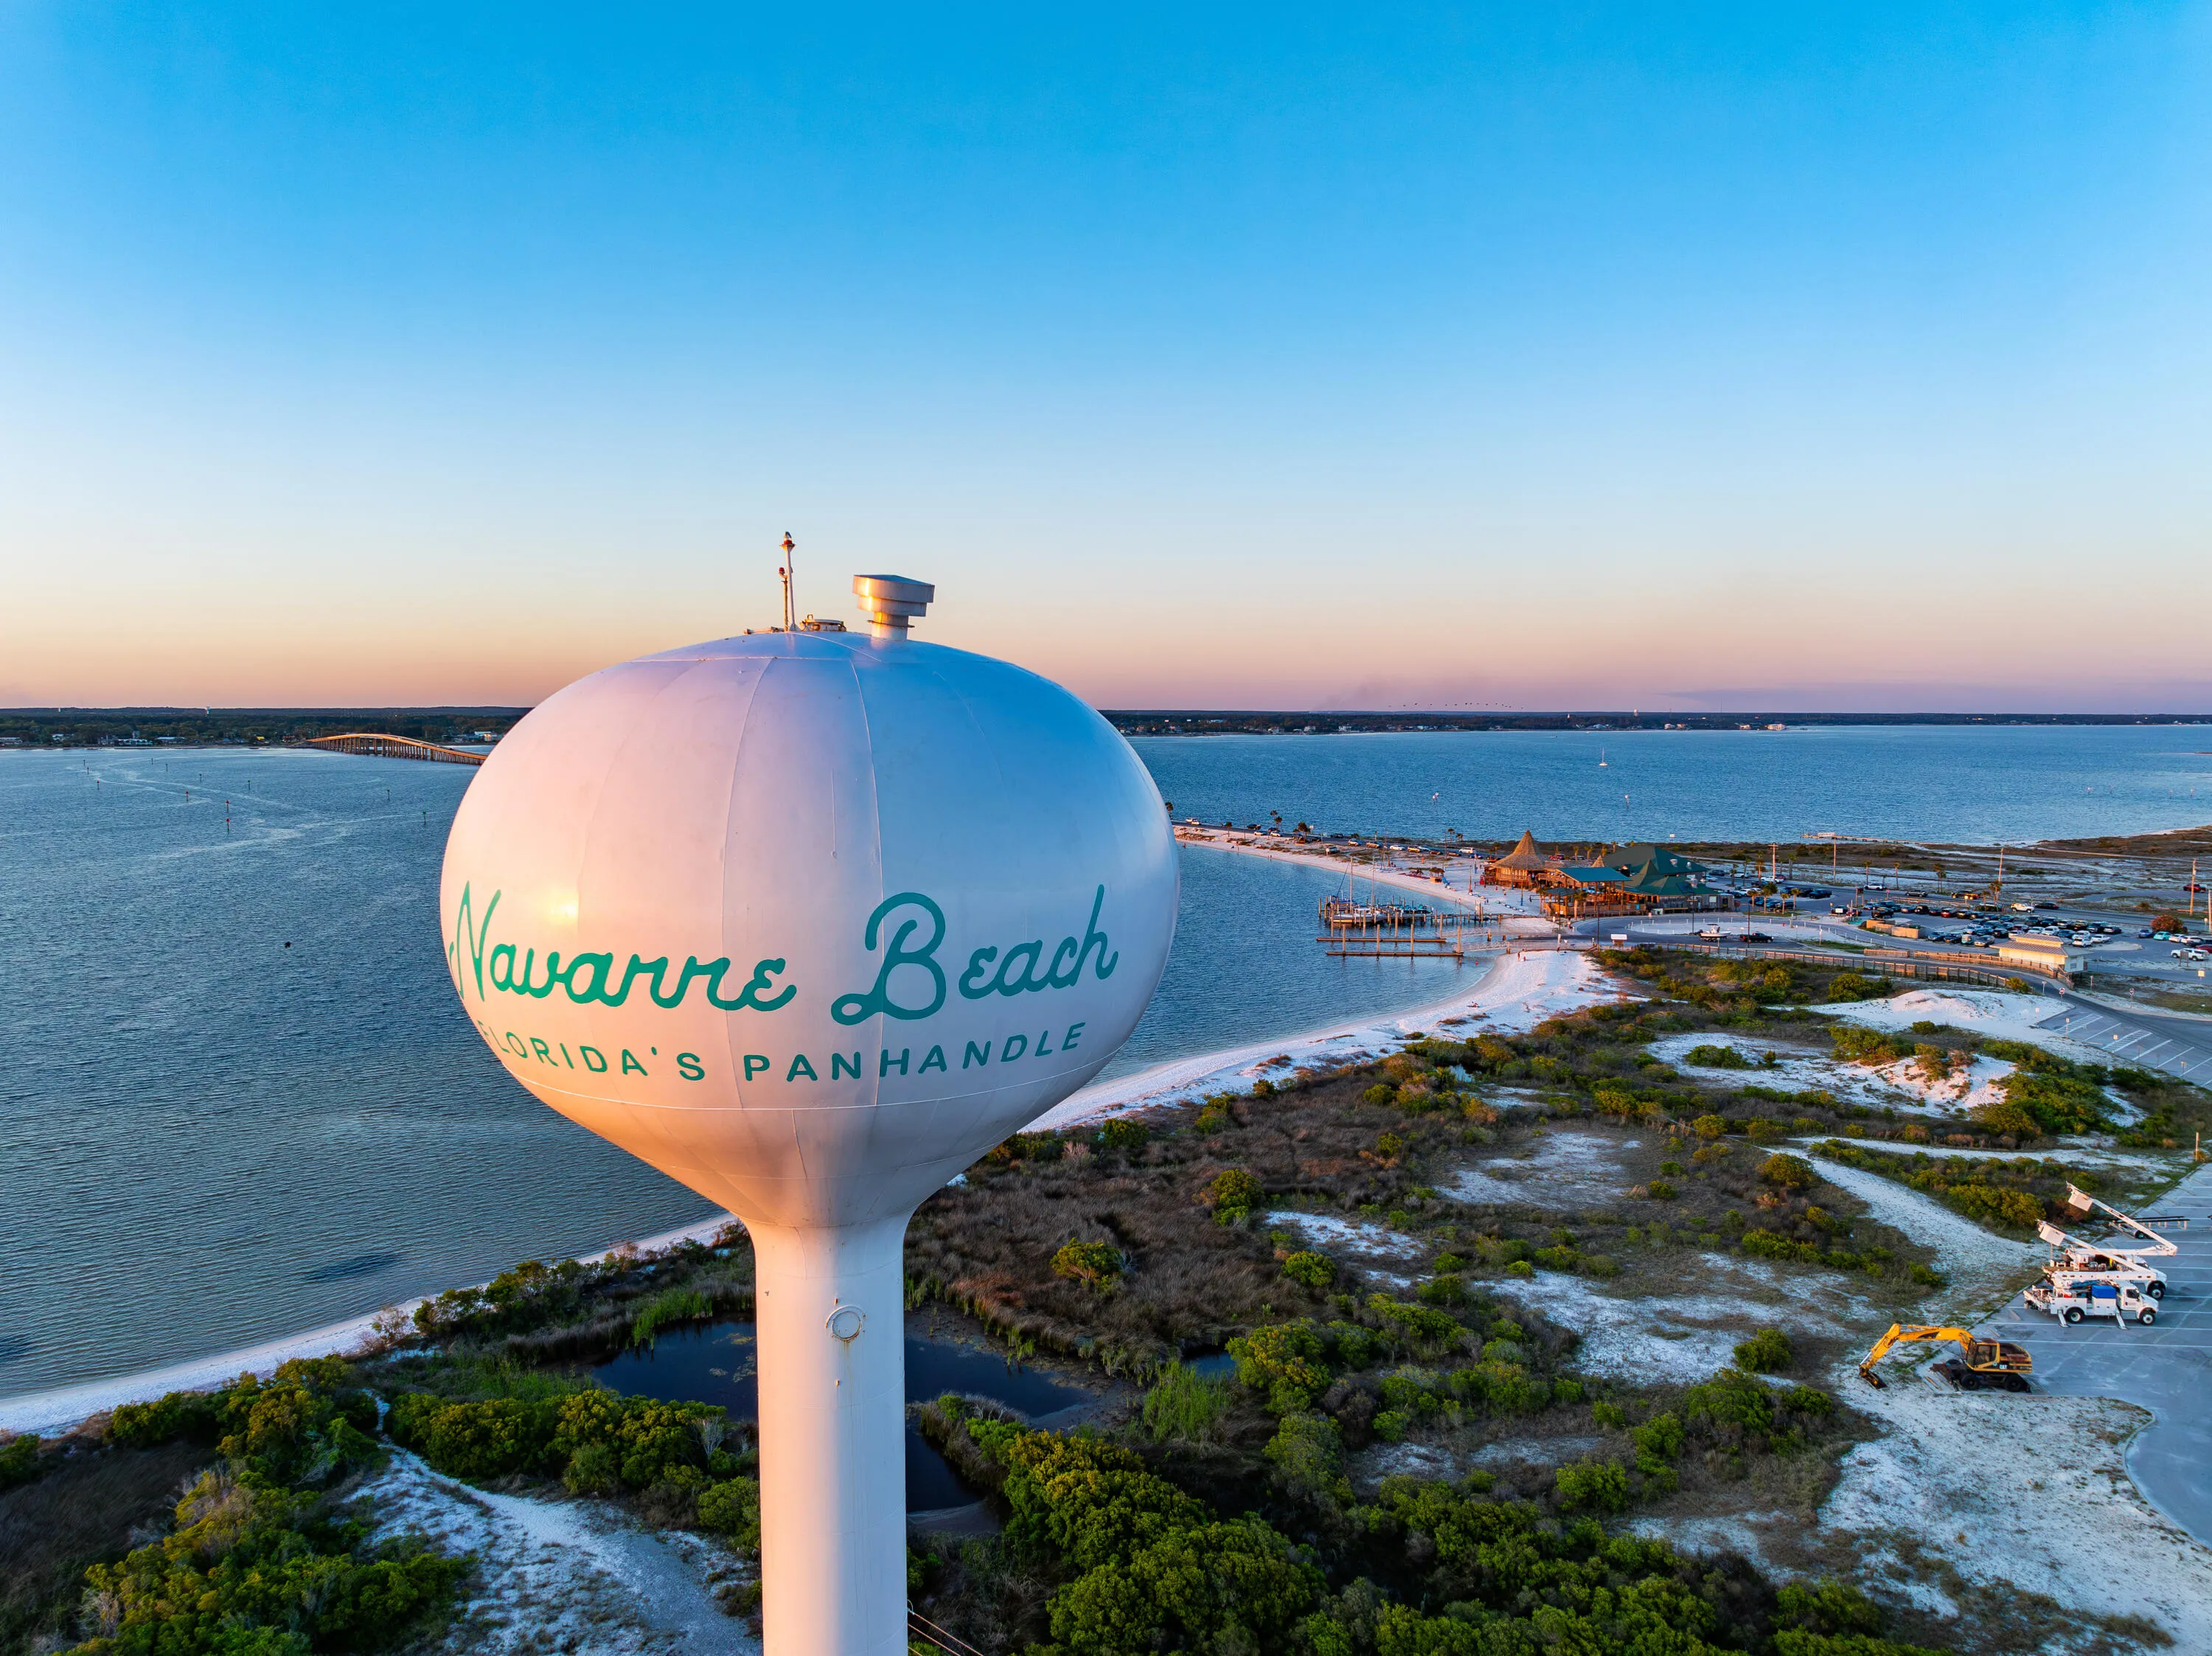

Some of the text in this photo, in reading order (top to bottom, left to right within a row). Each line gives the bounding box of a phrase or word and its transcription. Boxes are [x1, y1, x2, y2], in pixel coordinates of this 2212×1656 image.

[449, 880, 1119, 1026] Navarre Beach
[477, 1020, 1086, 1082] FLORIDA'S PANHANDLE
